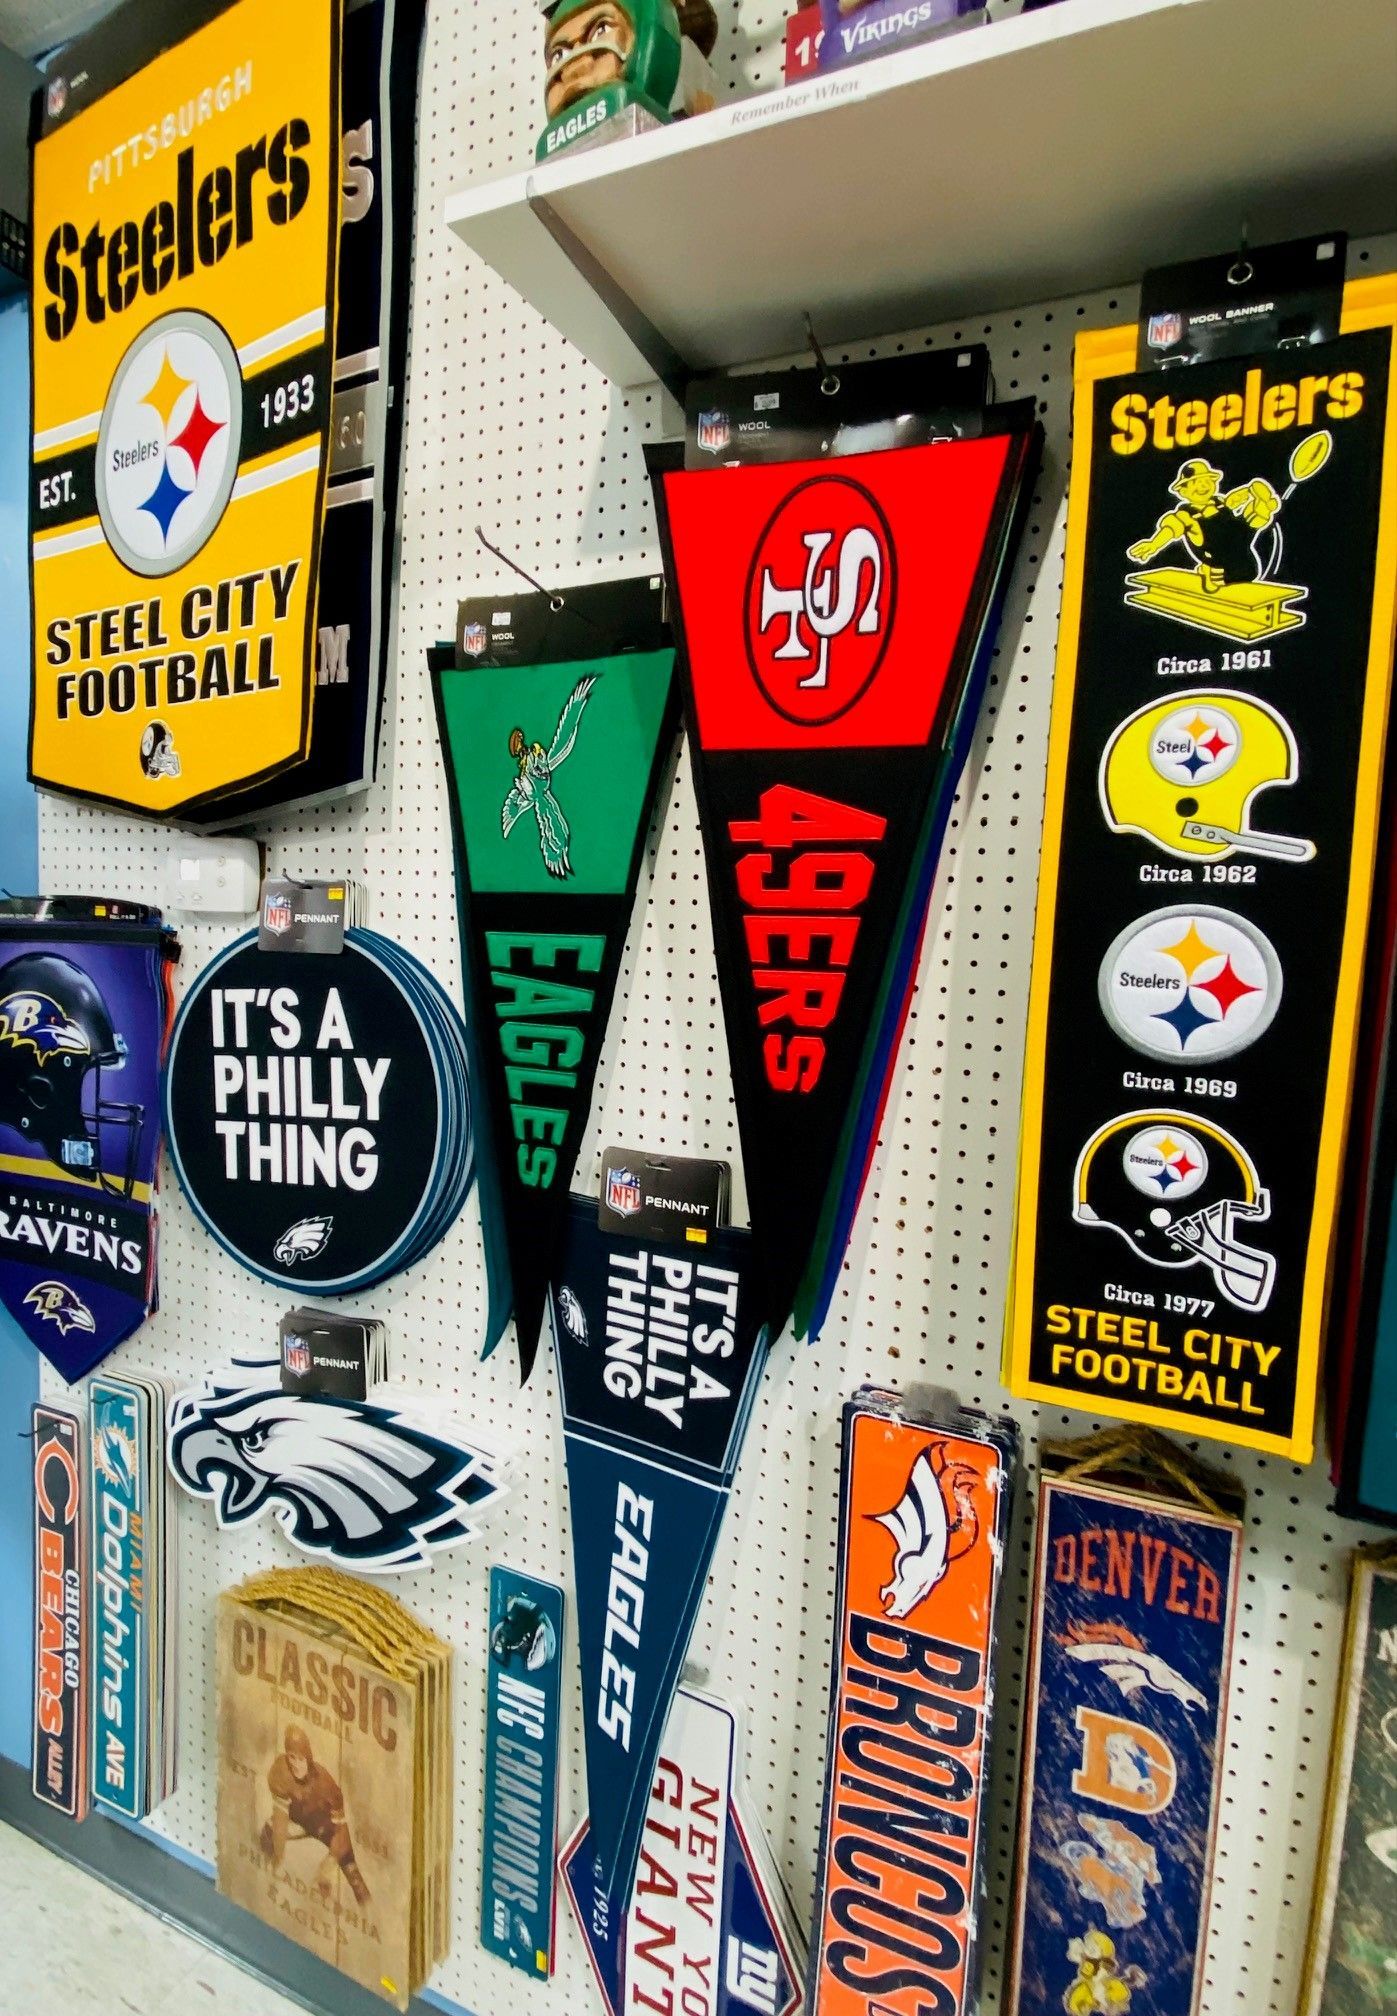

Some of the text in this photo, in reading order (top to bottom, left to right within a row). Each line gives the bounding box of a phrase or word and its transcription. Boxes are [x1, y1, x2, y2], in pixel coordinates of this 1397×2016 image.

[88, 60, 253, 194] PITTSBURGH
[546, 99, 607, 153] EAGLES
[730, 78, 861, 126] Remember When
[44, 118, 311, 342] Steelers
[1189, 302, 1274, 325] WOOL BANNER
[261, 374, 314, 427] 1933
[738, 421, 771, 431] WOOL
[1110, 368, 1366, 456] Steelers
[38, 470, 76, 509] EST.
[112, 438, 160, 473] Steelers
[46, 558, 301, 667] STEEL CITY
[492, 632, 515, 641] WOOL
[56, 636, 281, 720] FOOTBALL
[1156, 649, 1272, 675] Circa 1961
[1156, 739, 1191, 755] Steel
[1139, 865, 1256, 884] Circa 1962
[294, 914, 340, 923] PENNANT
[728, 784, 887, 1094] 49ERS
[1119, 973, 1180, 990] Steelers
[211, 987, 354, 1050] IT'S A
[213, 1055, 391, 1121] PHILLY
[485, 931, 607, 1189] EAGLES
[1122, 1071, 1238, 1098] Circa 1969
[215, 1121, 379, 1192] THING
[1129, 1153, 1164, 1167] Steelers
[9, 1195, 117, 1229] BALTIMORE
[612, 1184, 640, 1209] NFL
[645, 1195, 709, 1216] PENNANT
[603, 1250, 648, 1400] THING
[689, 1264, 740, 1400] IT'S A
[1104, 1283, 1215, 1319] Circa 1977
[313, 1356, 359, 1370] PENNANT
[644, 1254, 693, 1430] PHILLY
[1046, 1304, 1282, 1377] STEEL CITY
[1051, 1344, 1265, 1416] FOOTBALL
[129, 1510, 145, 1616] MIAMI
[1054, 1529, 1222, 1622] DENVER
[38, 1527, 66, 1738] BEARS
[64, 1568, 81, 1690] CHICAGO
[98, 1496, 133, 1791] Dolphins AVE
[598, 1481, 654, 1753] EAGLES
[232, 1617, 398, 1752] CLASSIC
[496, 1672, 545, 1740] NFC
[493, 1734, 544, 1914] CHAMPIONS
[826, 1611, 981, 2016] BRONCOS
[686, 1776, 720, 1928] NEW
[593, 1885, 609, 1941] 1925
